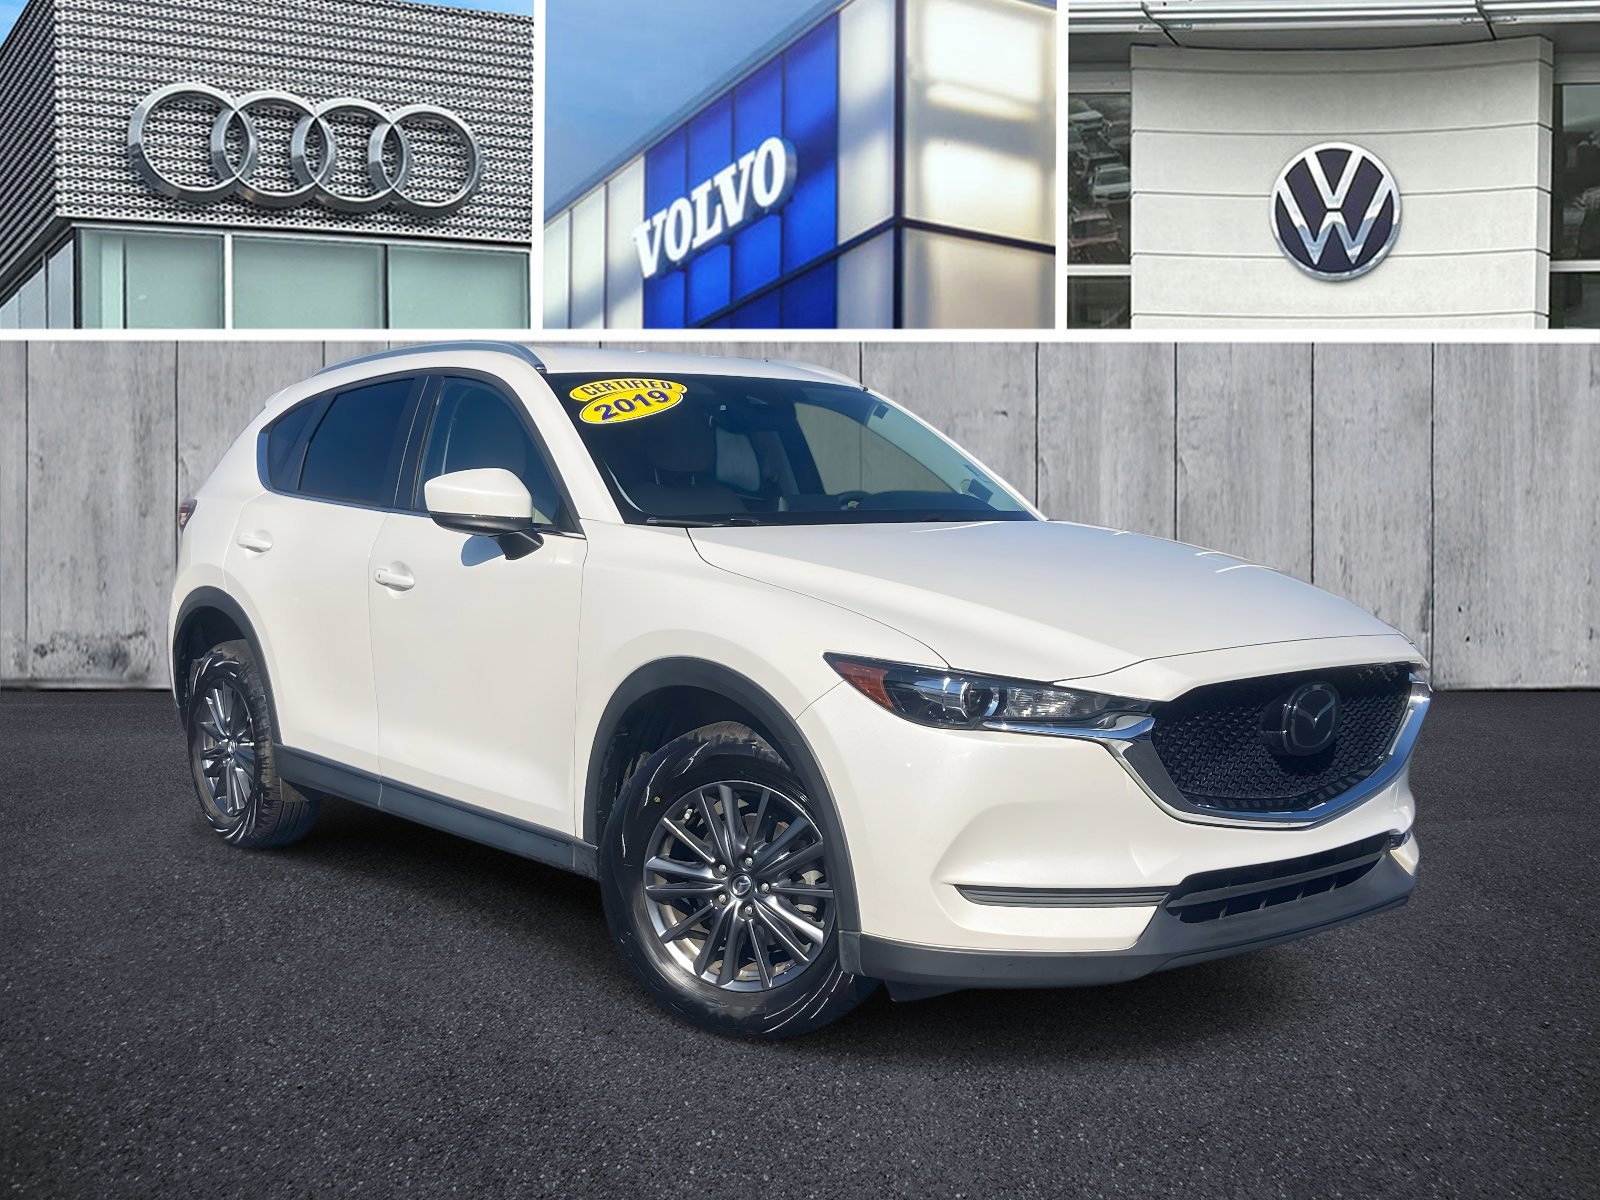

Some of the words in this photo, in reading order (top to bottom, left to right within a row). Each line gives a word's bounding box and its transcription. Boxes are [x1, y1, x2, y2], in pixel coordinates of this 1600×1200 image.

[633, 136, 790, 278] VOLVO
[580, 379, 673, 396] CERTIFIED
[594, 390, 670, 421] 2019
